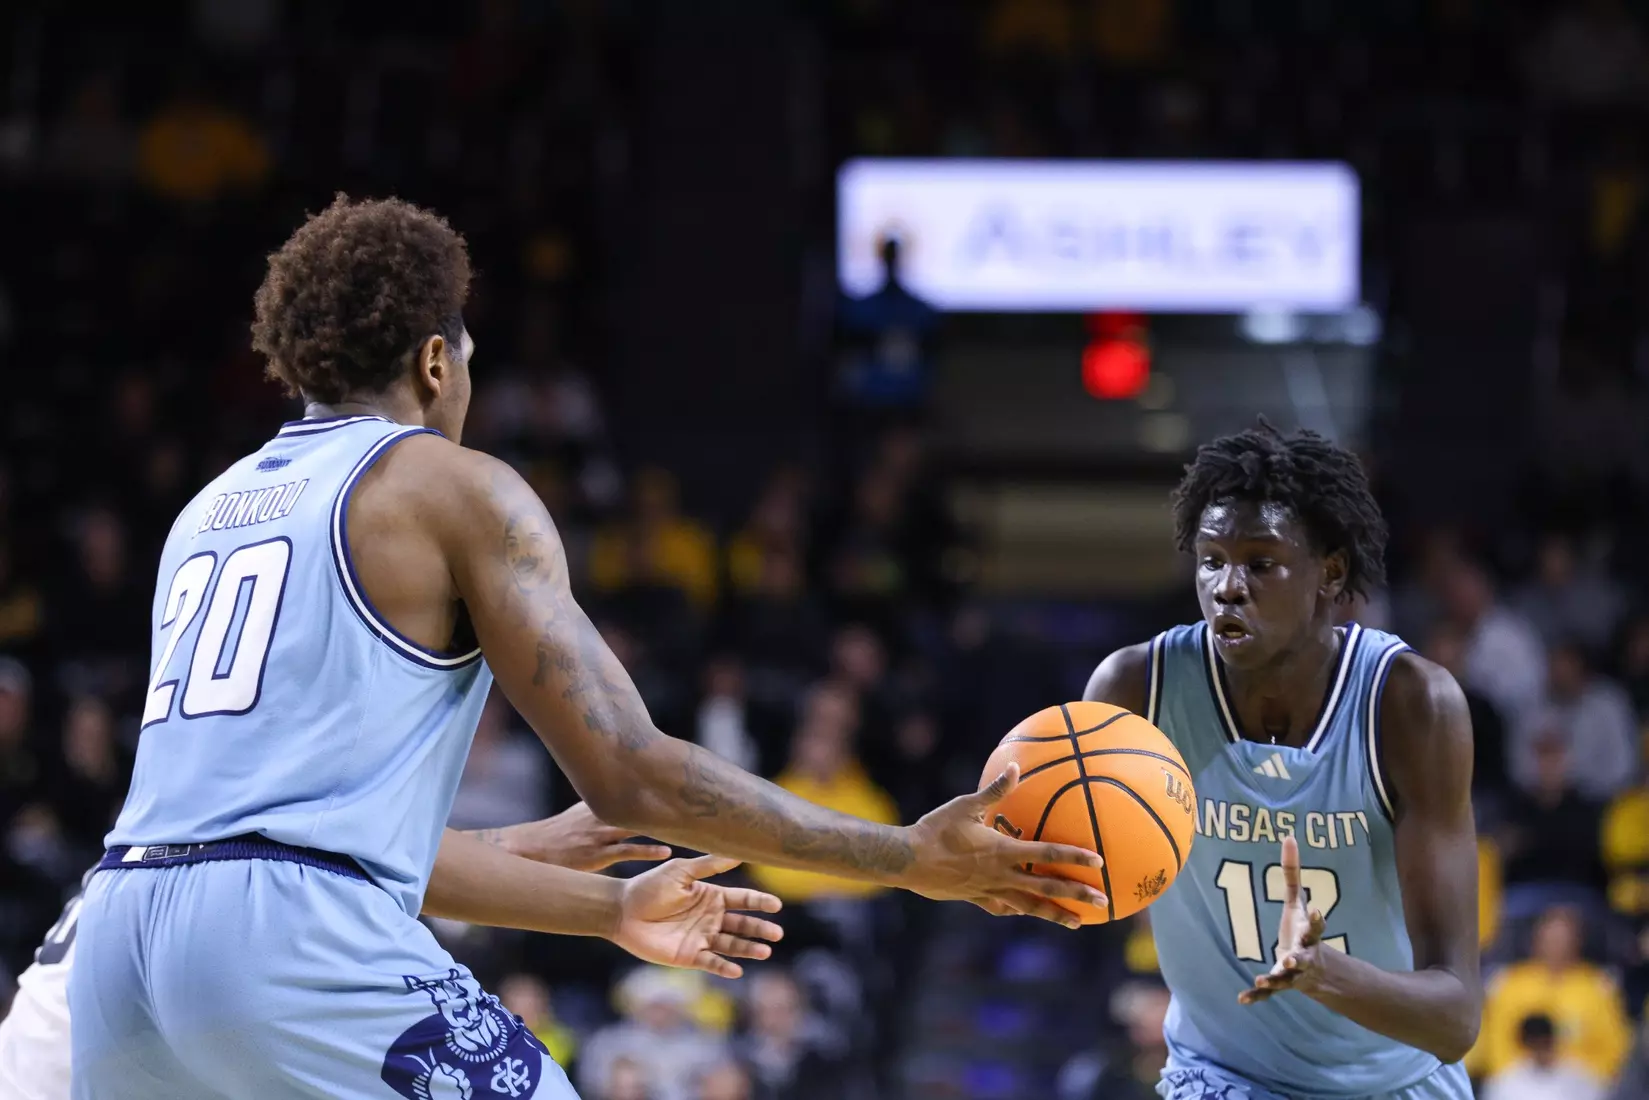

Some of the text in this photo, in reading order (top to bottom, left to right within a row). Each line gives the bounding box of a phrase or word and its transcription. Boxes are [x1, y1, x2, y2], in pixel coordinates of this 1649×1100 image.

[192, 479, 309, 539] BONKOLI
[140, 535, 293, 733] 20
[1195, 798, 1296, 845] NSAS
[1214, 858, 1350, 964] 12
